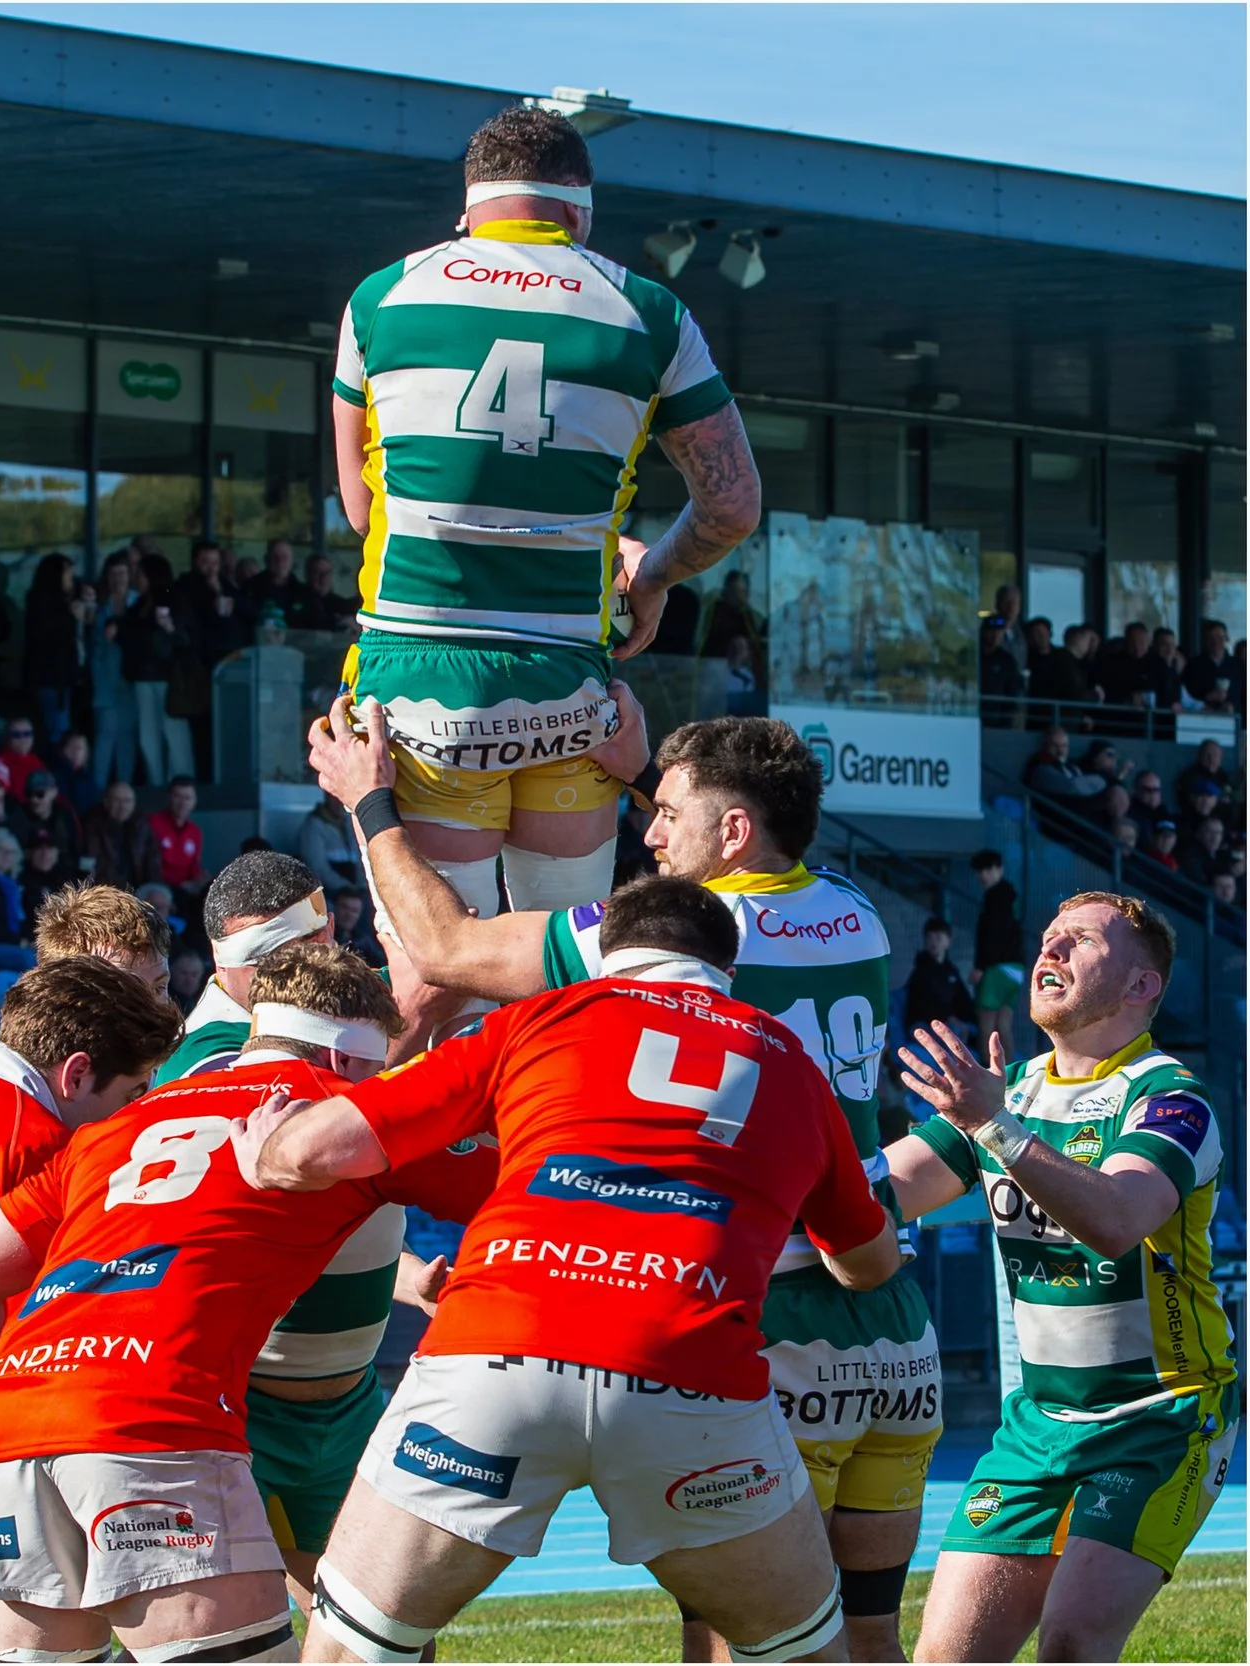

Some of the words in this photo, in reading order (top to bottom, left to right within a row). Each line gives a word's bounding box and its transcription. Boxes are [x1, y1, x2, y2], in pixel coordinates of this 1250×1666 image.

[443, 258, 582, 293] Compra
[455, 338, 555, 457] 4
[431, 719, 504, 736] LITTLE
[508, 716, 542, 734] BIG
[547, 703, 600, 729] BREW
[839, 745, 950, 788] Garenne
[756, 908, 861, 944] Compra
[627, 1027, 761, 1147] 4
[104, 1115, 230, 1212] 8
[484, 1239, 728, 1300] PENDERYN
[549, 1268, 648, 1291] DISTILLERY
[881, 1361, 905, 1380] BIG
[403, 1439, 505, 1485] Weightmans
[682, 1472, 750, 1498] National
[685, 1491, 742, 1511] League
[745, 1471, 781, 1501] Rugby
[104, 1517, 170, 1535] National
[107, 1536, 162, 1554] League
[166, 1530, 215, 1555] Rugby
